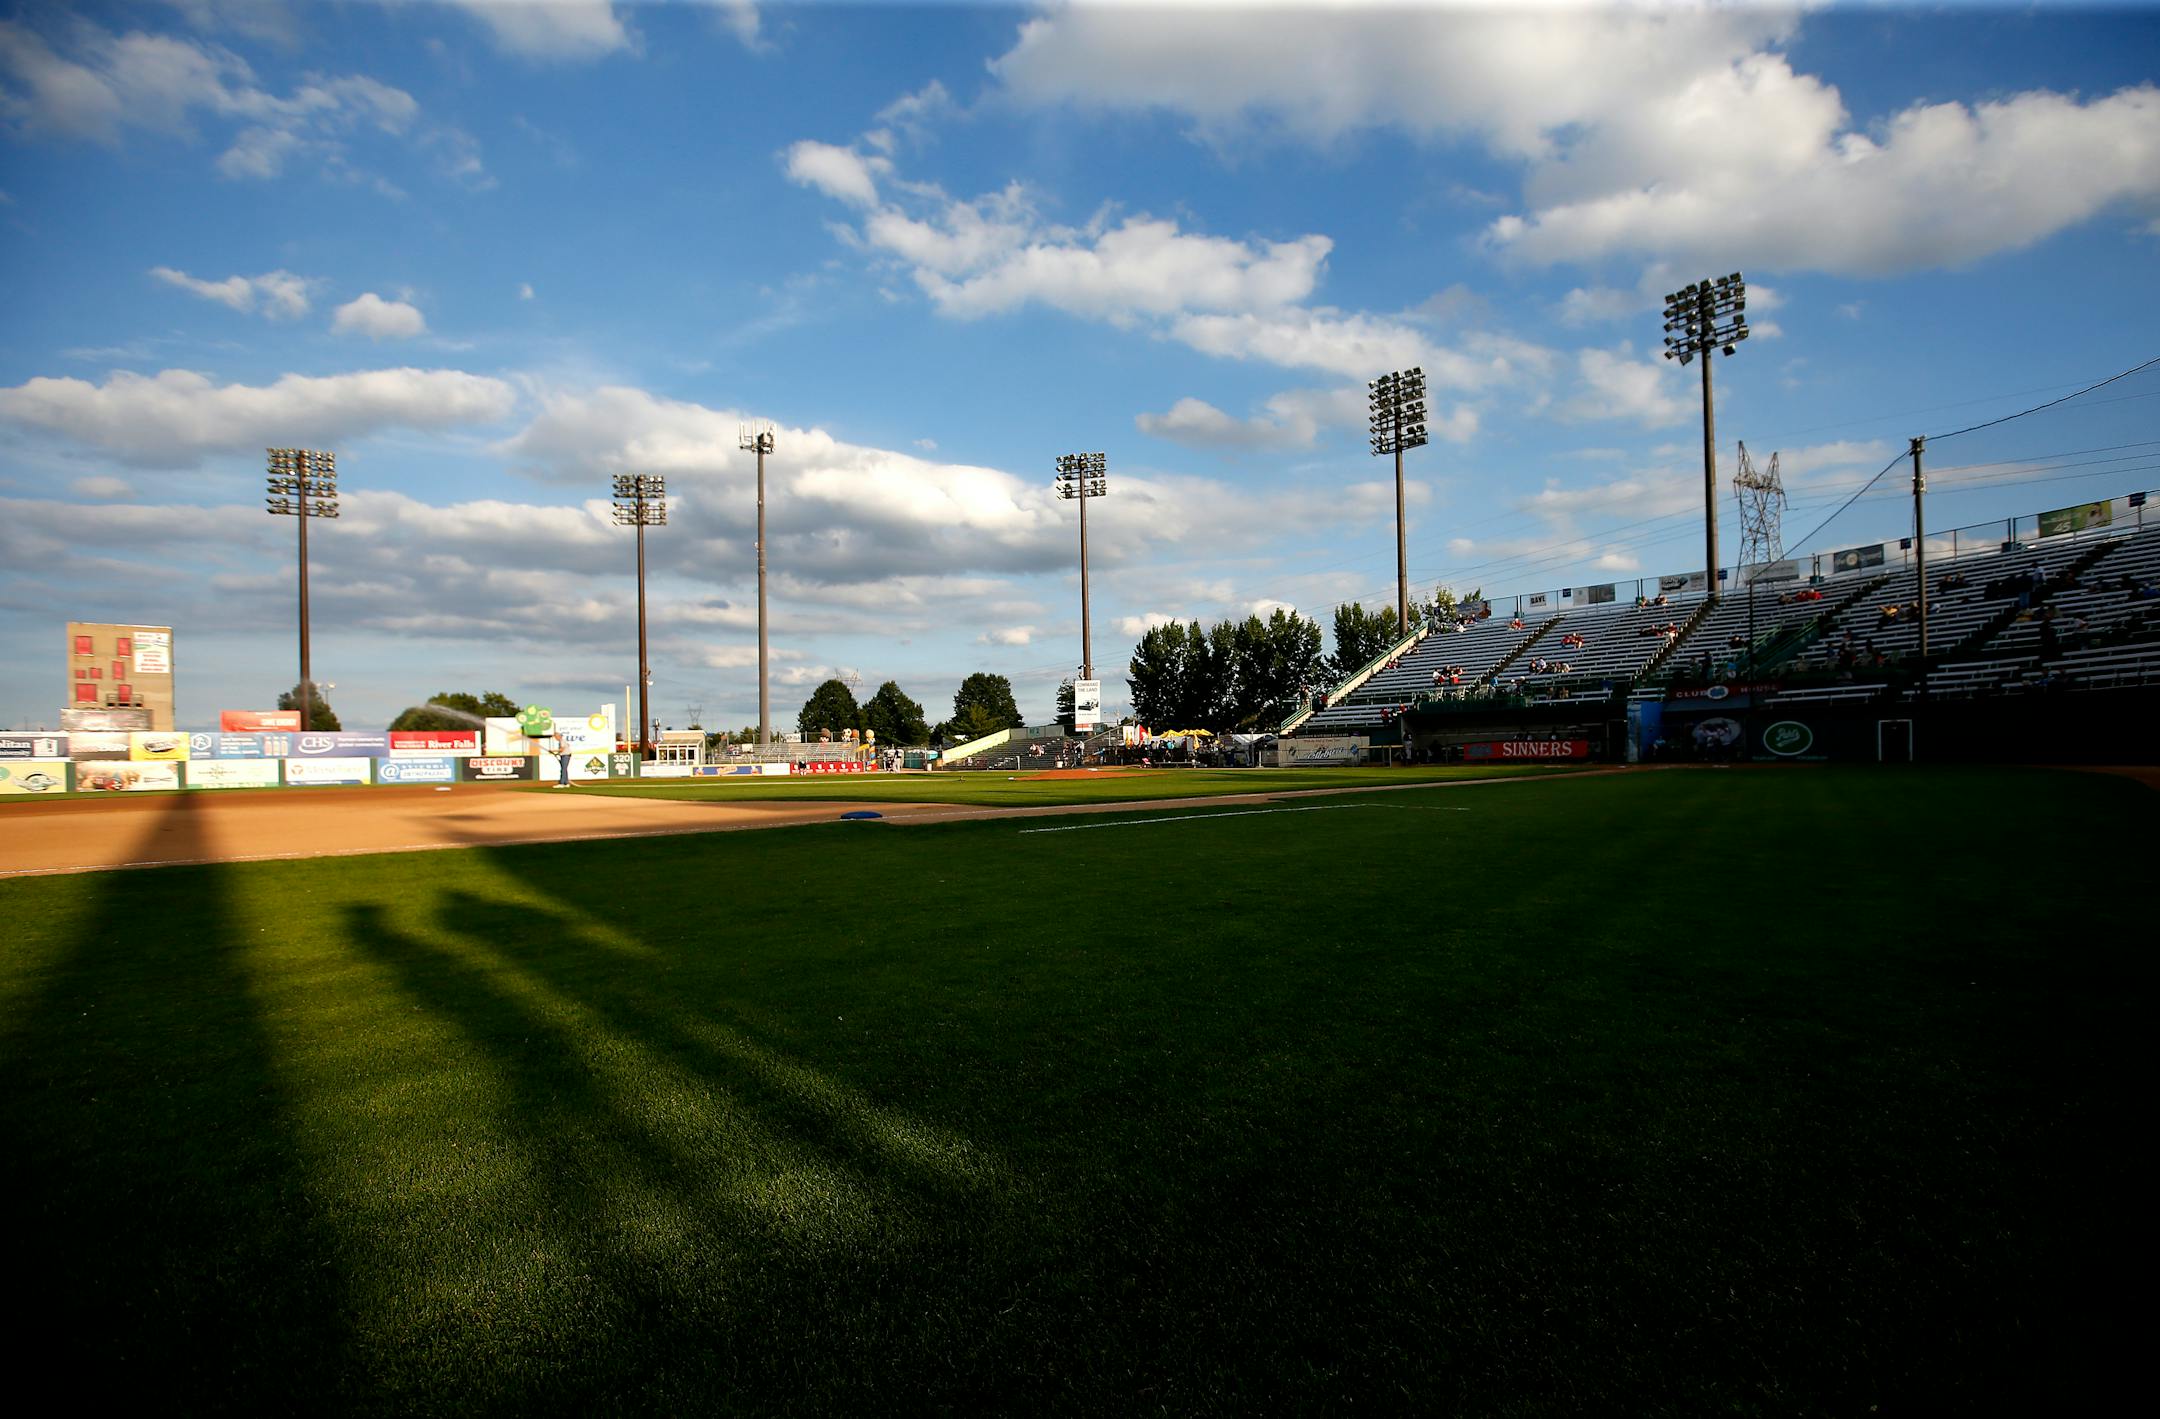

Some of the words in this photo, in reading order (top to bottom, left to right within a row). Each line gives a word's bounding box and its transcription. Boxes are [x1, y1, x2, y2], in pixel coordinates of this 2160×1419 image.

[302, 735, 332, 748] CHS
[428, 739, 453, 749] River
[453, 739, 475, 749] Falls
[1502, 741, 1573, 757] SINNERS
[470, 758, 525, 768] DISCOUNT
[613, 754, 631, 763] 320
